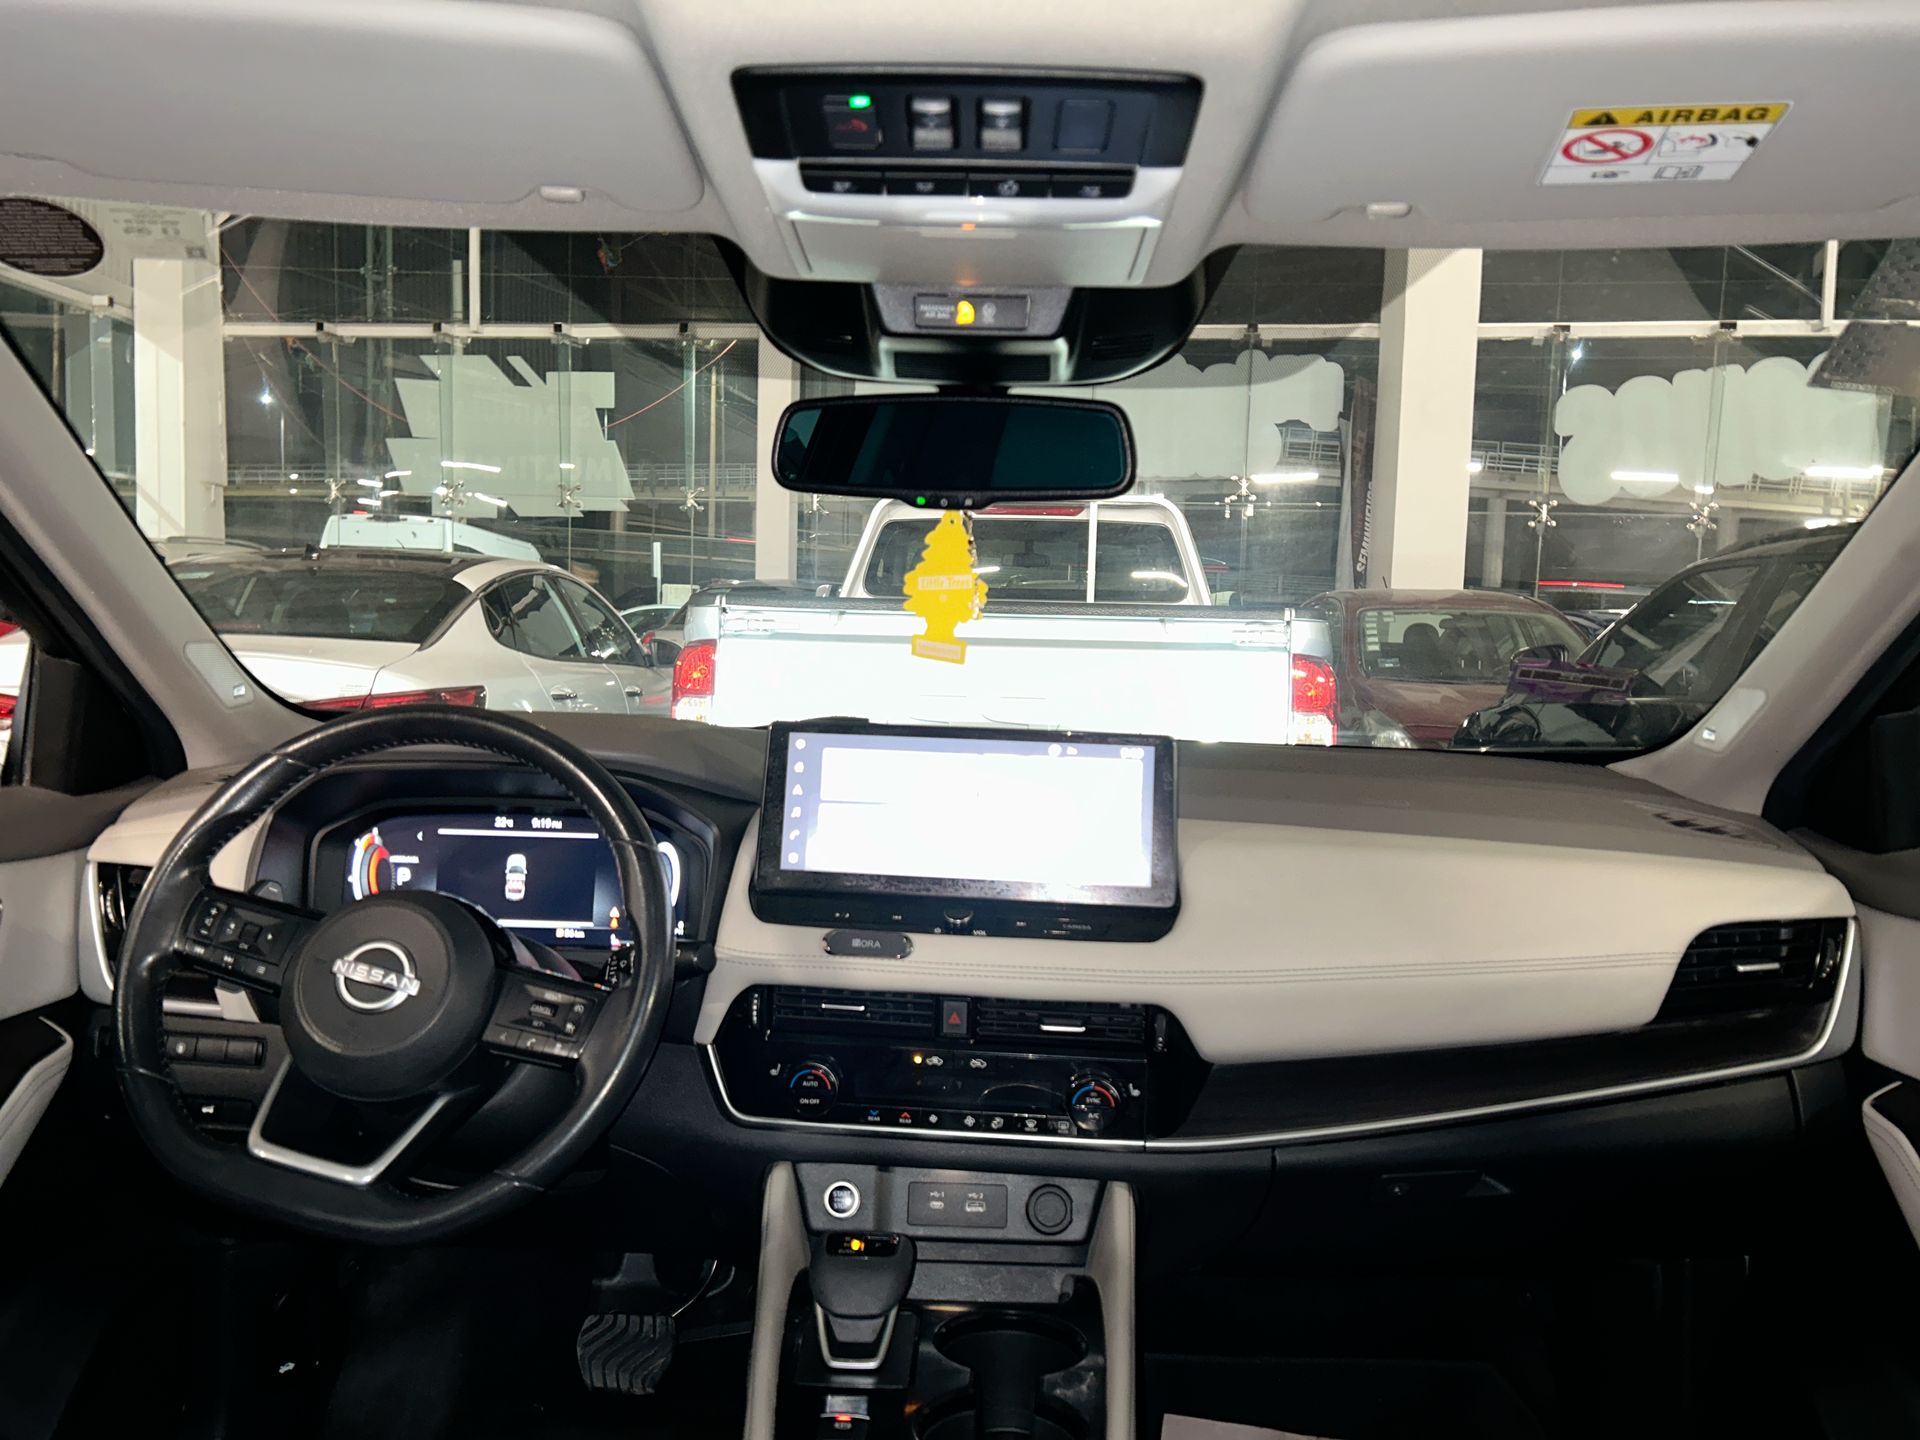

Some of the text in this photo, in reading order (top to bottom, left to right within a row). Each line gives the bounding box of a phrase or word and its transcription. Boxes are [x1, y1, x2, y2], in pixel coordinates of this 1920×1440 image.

[1634, 107, 1769, 125] AIRBAG
[396, 866, 411, 886] P
[333, 960, 418, 995] NISSAN
[1085, 1096, 1101, 1104] SYNC
